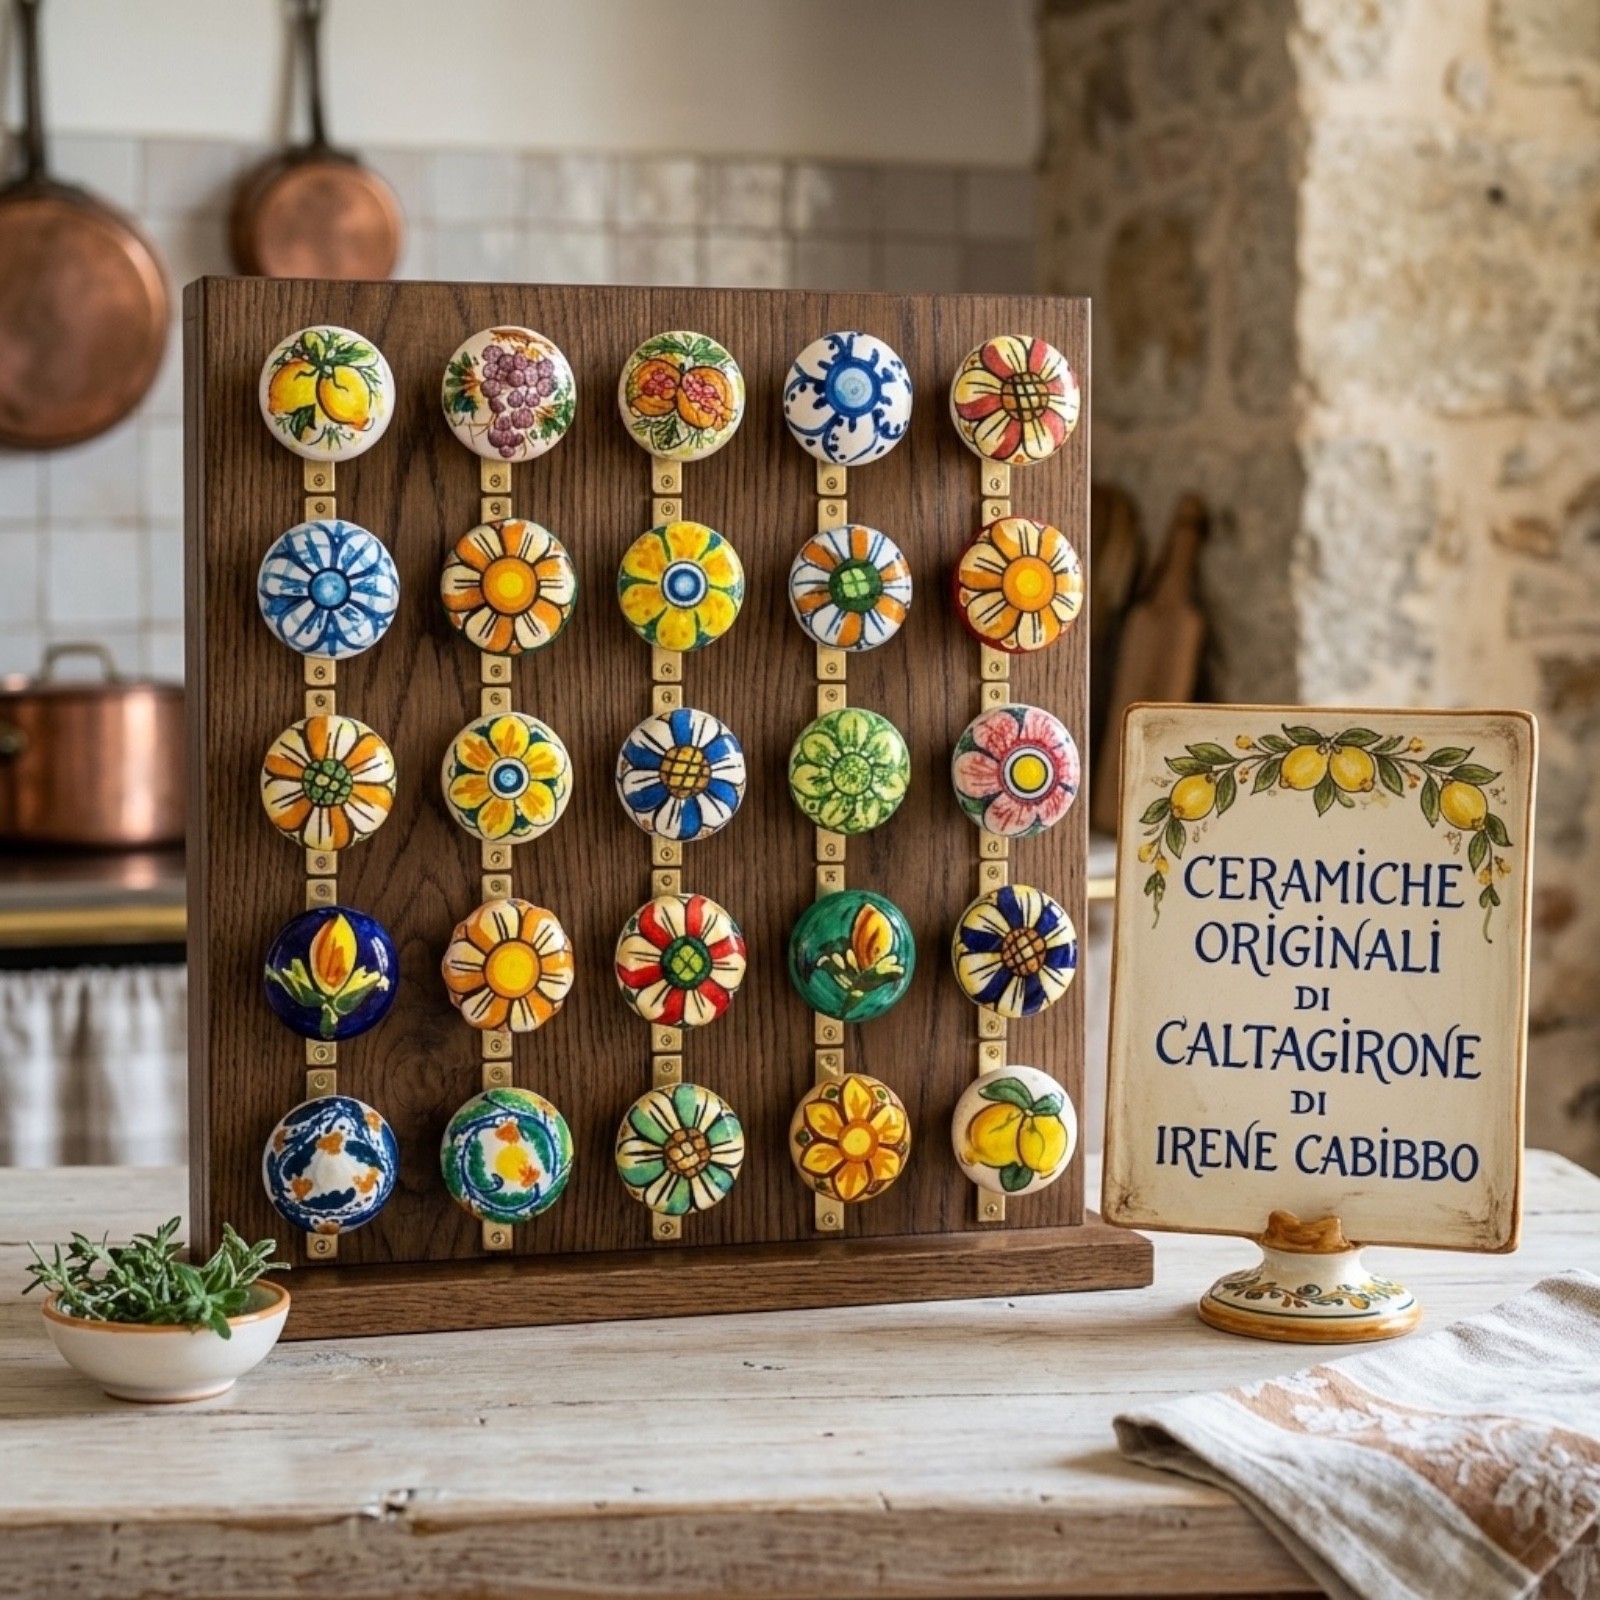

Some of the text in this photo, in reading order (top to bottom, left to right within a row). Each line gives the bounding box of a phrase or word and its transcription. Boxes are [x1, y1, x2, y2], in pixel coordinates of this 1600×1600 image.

[1294, 985, 1331, 1011] DI
[1290, 1090, 1328, 1115] DI
[1156, 1119, 1278, 1178] IRENE
